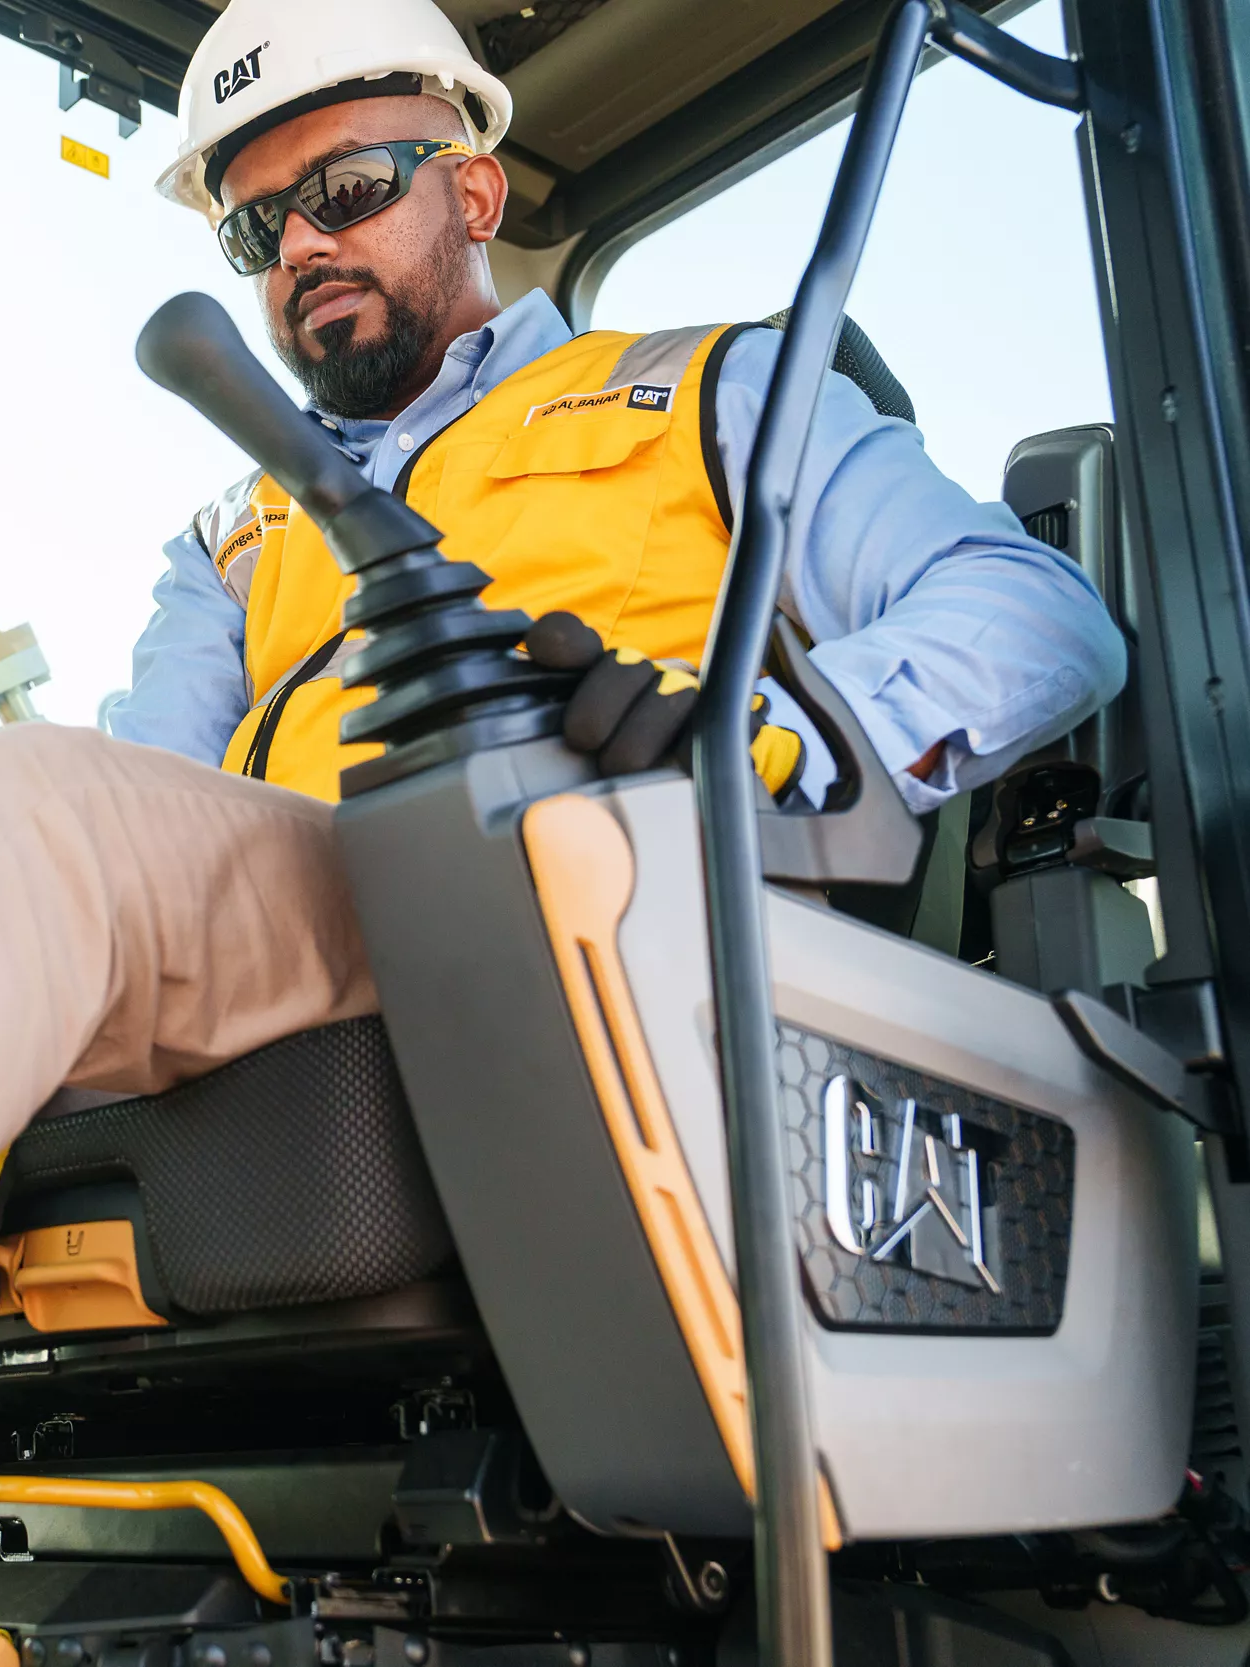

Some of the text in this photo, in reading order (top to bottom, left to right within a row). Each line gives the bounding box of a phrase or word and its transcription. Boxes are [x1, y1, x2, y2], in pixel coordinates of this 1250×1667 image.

[214, 44, 262, 104] CAT
[558, 388, 662, 410] AL-BAHAR CAT
[823, 1074, 1011, 1294] CAT
